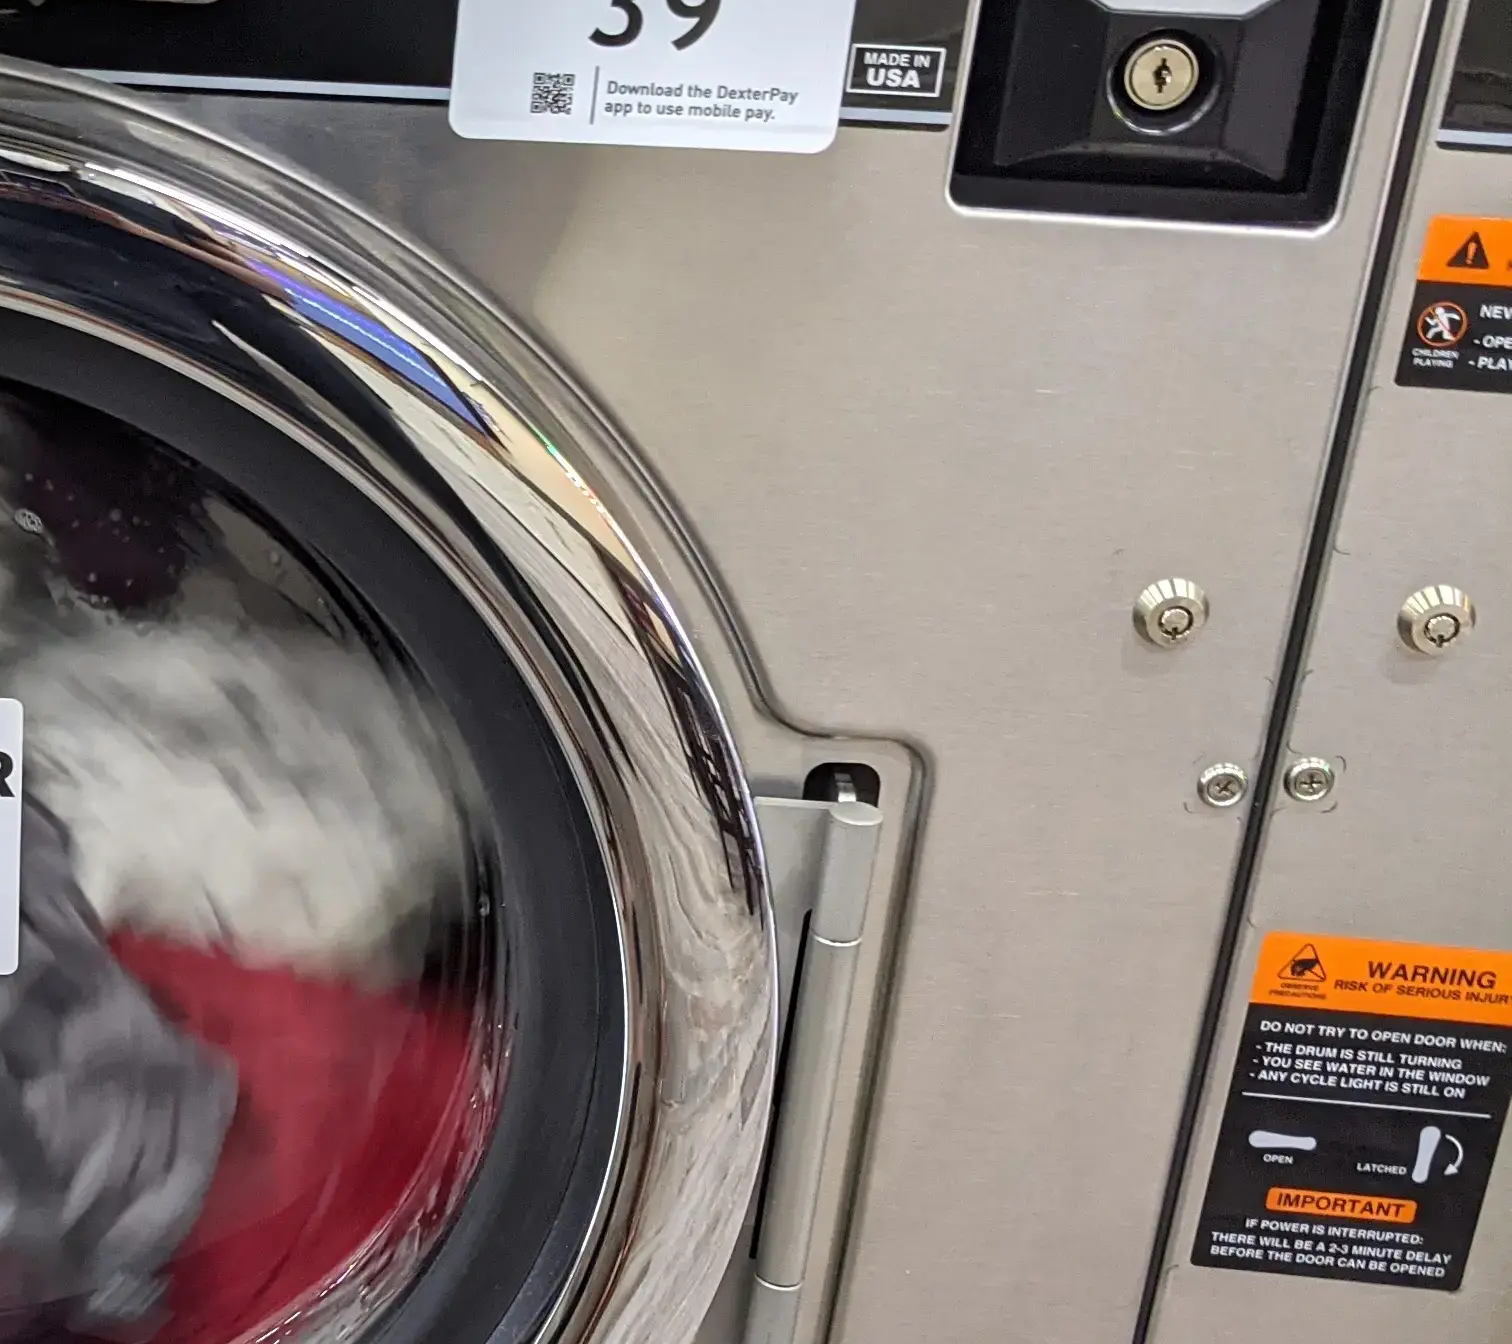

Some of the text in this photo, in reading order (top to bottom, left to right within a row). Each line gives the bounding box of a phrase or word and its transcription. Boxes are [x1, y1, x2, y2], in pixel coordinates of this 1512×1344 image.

[863, 52, 930, 68] MADE IN
[866, 68, 920, 88] USA
[607, 81, 798, 105] Download the DexterPay
[605, 101, 775, 122] app to use mobile pay.
[1368, 961, 1497, 989] WARNING
[1334, 980, 1368, 992] RISK
[1372, 983, 1392, 994] OF
[1396, 985, 1461, 1000] SERIOUS
[1260, 1020, 1507, 1053] DO NOT TRY TO OPEN DOOR WHEN:
[1265, 1042, 1462, 1070] THE DRUM IS STILL TURNING
[1262, 1056, 1490, 1086] YOU SEE WATER IN THE WINDOW
[1257, 1070, 1466, 1099] ANY CYCLE LIGHT IS STILL ON
[1263, 1154, 1293, 1164] OPEN
[1356, 1163, 1407, 1176] LATCHED
[1277, 1192, 1406, 1217] IMPORTANT
[1245, 1217, 1258, 1229] IF
[1260, 1219, 1309, 1233] POWER
[1312, 1223, 1325, 1234] IS
[1212, 1231, 1256, 1245] THERE
[1260, 1235, 1291, 1249] WILL
[1294, 1238, 1312, 1250] BE
[1316, 1241, 1325, 1252] A
[1352, 1245, 1403, 1260] MINUTE
[1406, 1250, 1452, 1264] DELAY
[1211, 1245, 1445, 1277] BEFORE THE DOOR CAN BE OPENED
